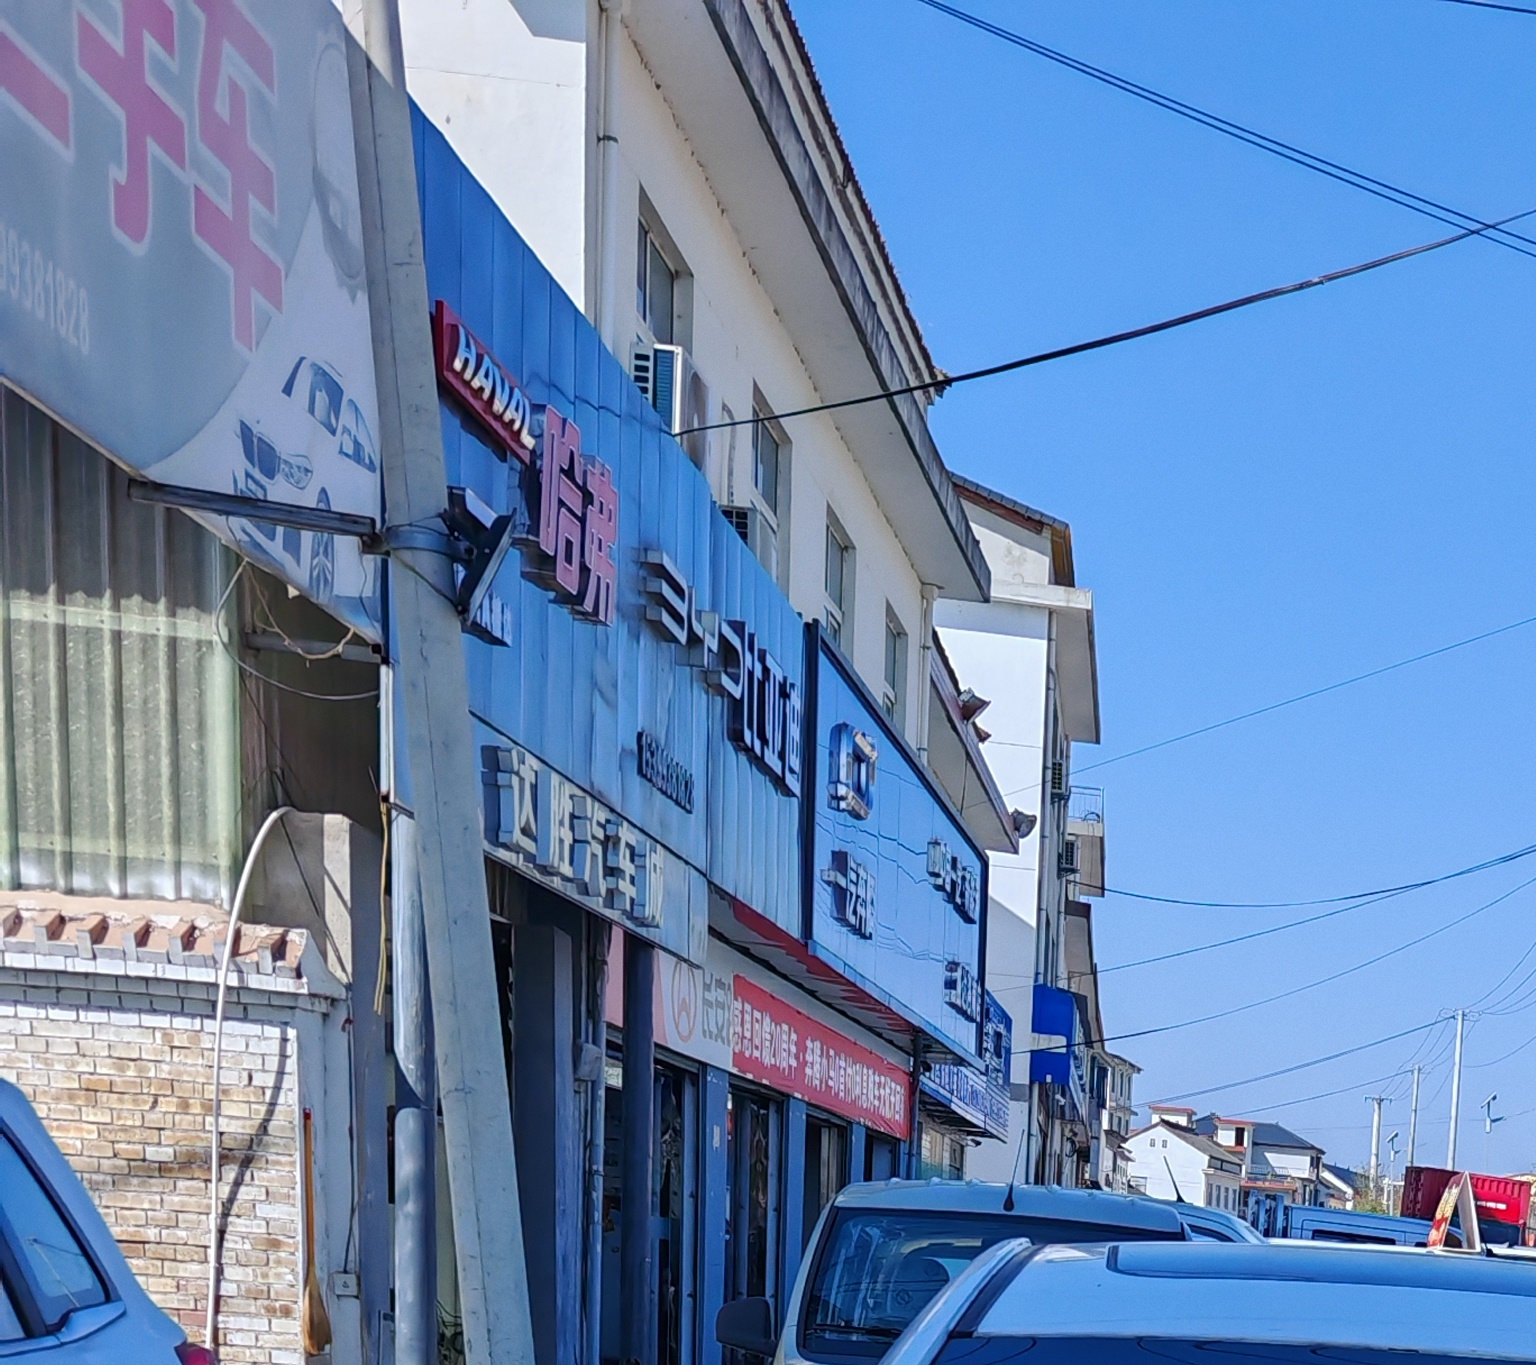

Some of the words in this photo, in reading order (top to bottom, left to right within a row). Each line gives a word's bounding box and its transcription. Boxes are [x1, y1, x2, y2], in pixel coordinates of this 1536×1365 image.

[453, 324, 536, 450] HAVAL
[539, 403, 618, 628] 哈弗
[741, 622, 801, 798] 比亚迪
[497, 745, 664, 927] 达胜汽车城
